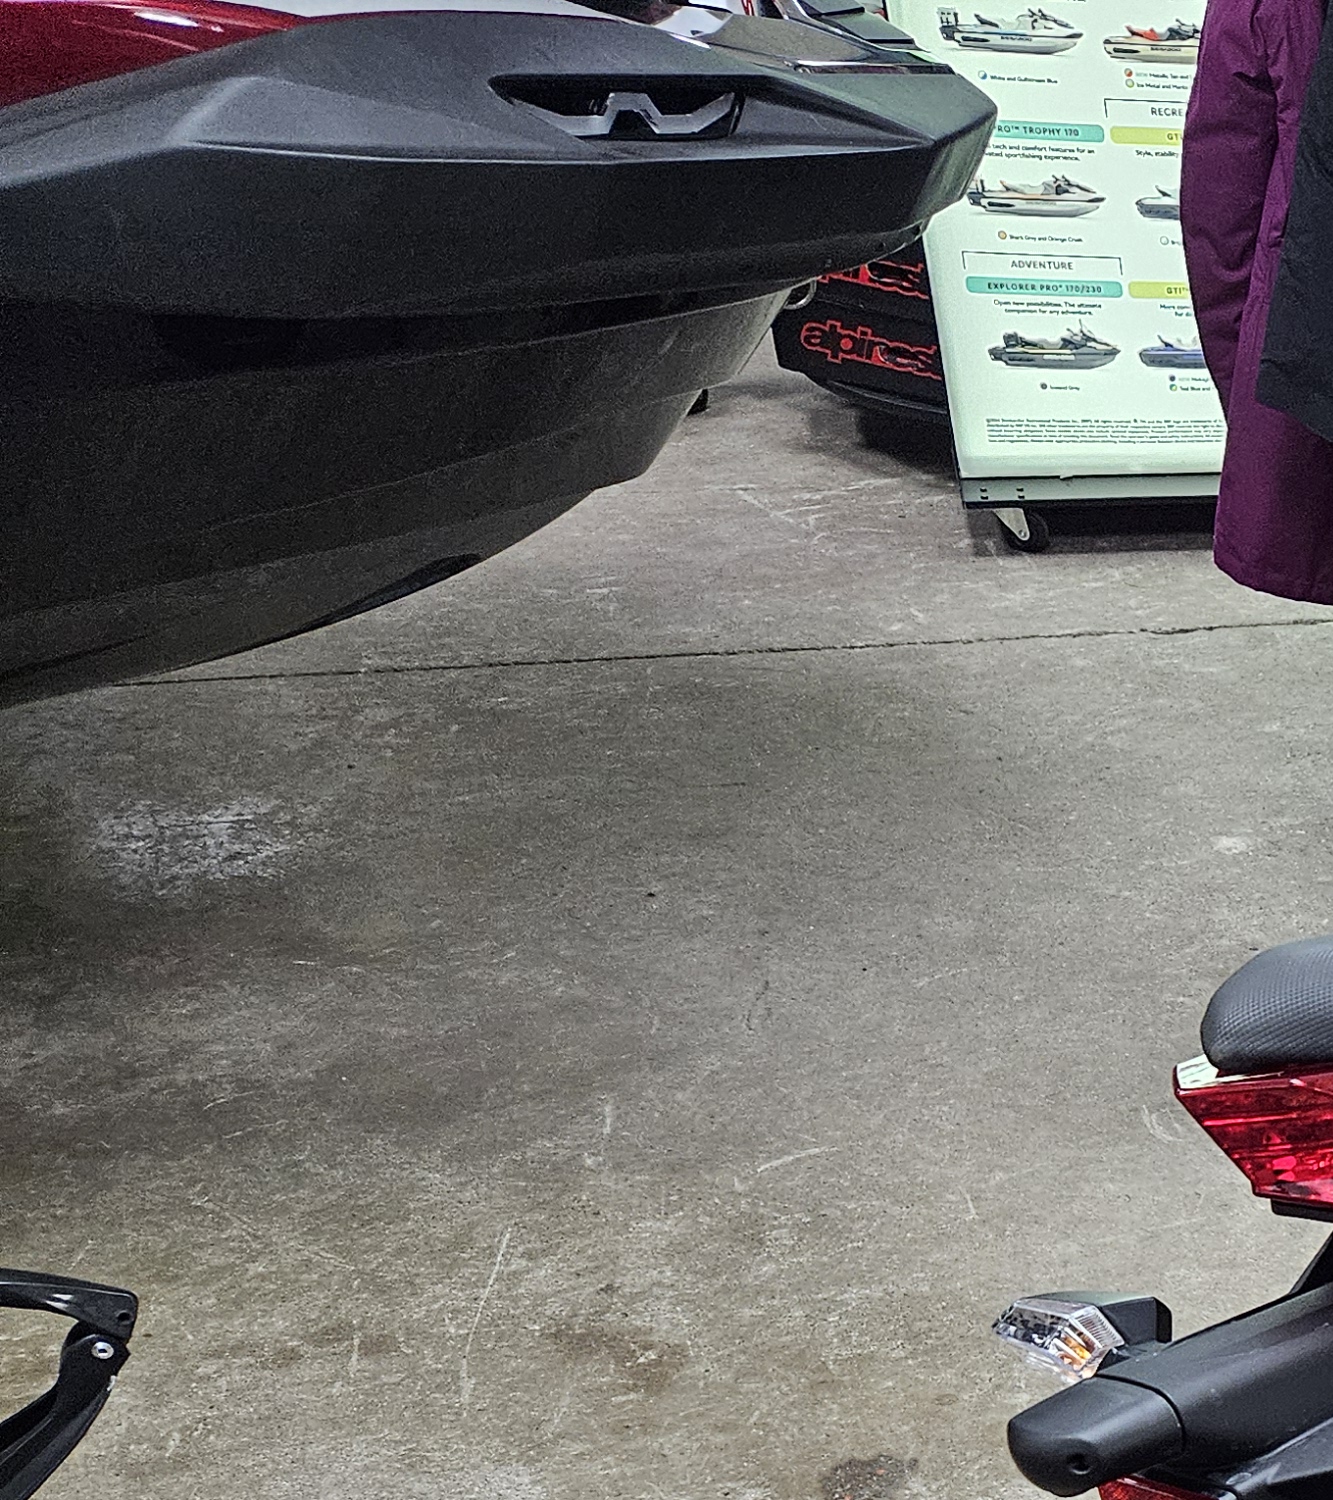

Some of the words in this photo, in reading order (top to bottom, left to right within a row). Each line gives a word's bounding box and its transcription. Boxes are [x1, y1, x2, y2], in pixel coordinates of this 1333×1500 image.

[1022, 126, 1061, 136] TROPHY
[1064, 128, 1080, 137] 170
[1011, 260, 1073, 270] ADVENTURE
[988, 282, 1037, 291] EXPLORER
[1065, 285, 1102, 293] 170/230
